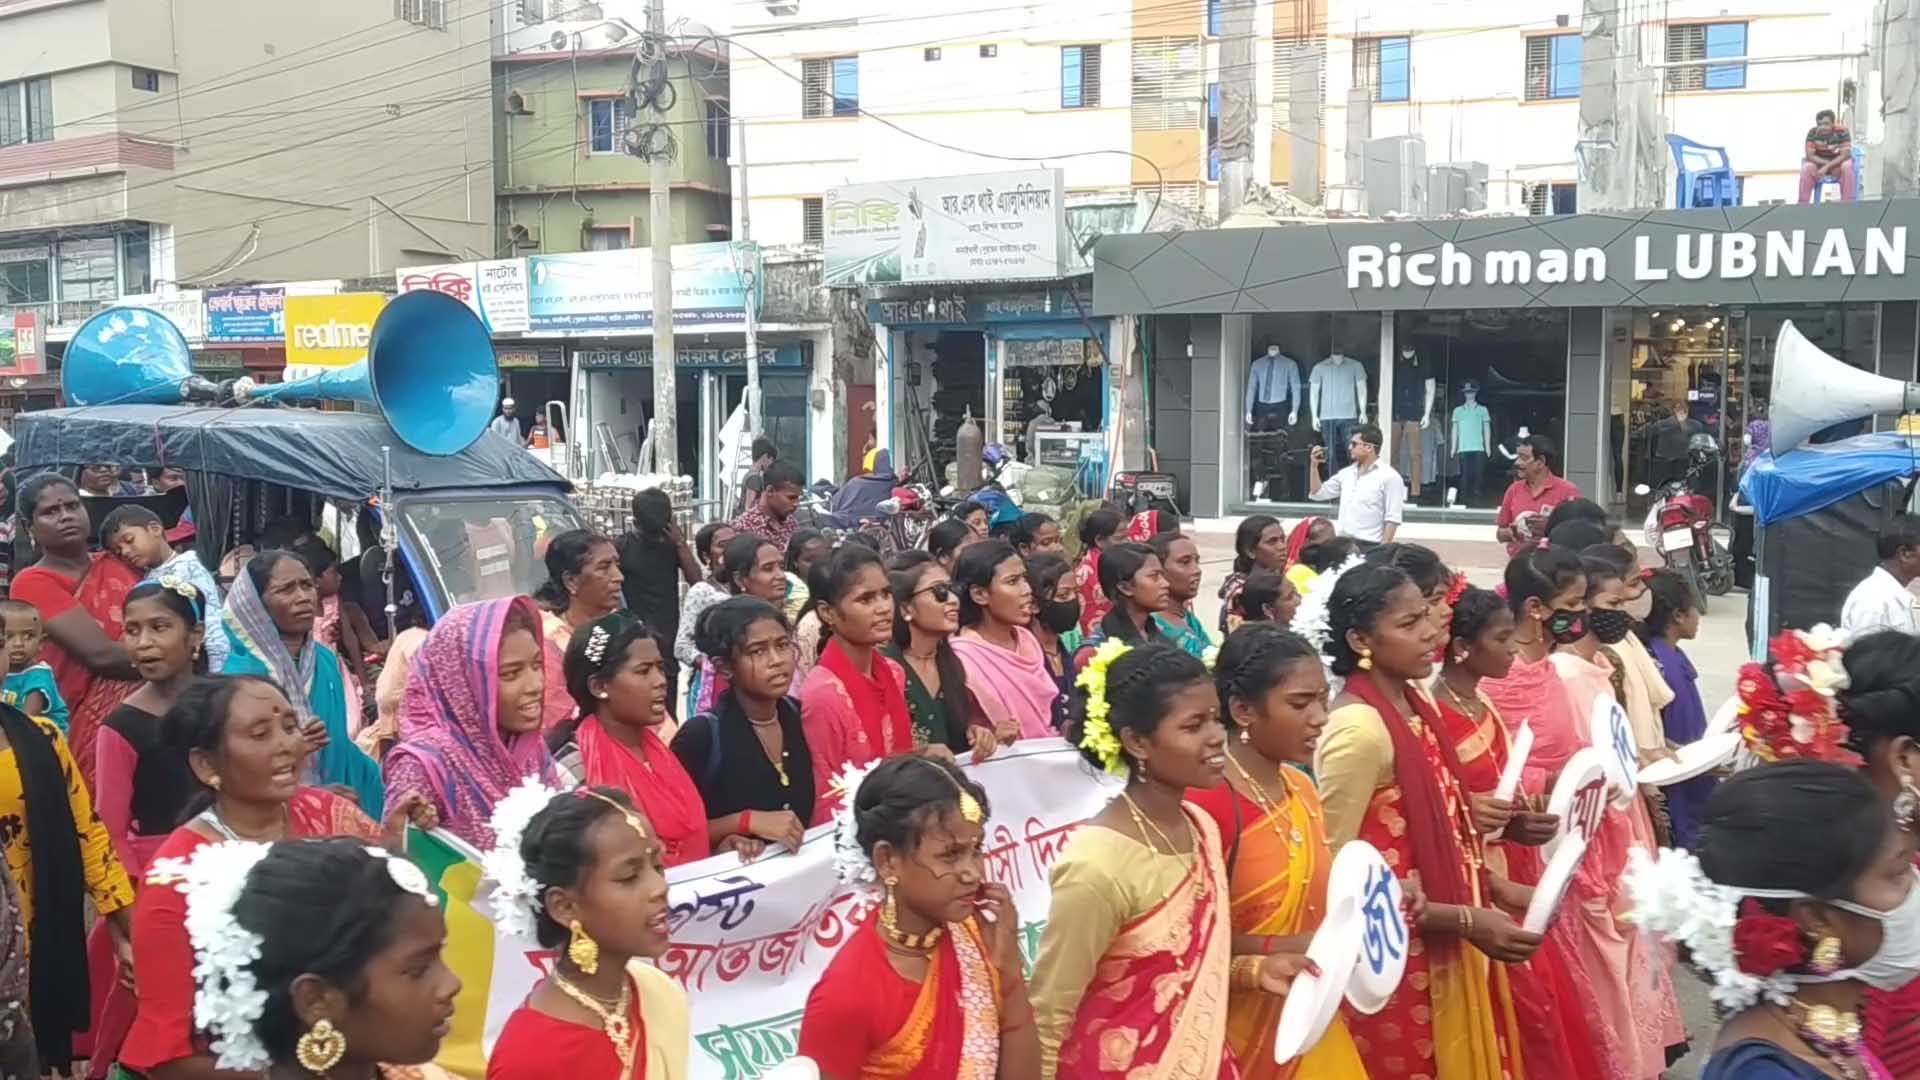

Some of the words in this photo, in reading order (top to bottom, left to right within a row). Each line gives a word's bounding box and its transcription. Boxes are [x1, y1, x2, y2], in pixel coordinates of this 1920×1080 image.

[1347, 242, 1472, 289] Rich
[1485, 247, 1607, 285] man
[1634, 226, 1907, 281] LUBNAN
[294, 318, 369, 349] realme
